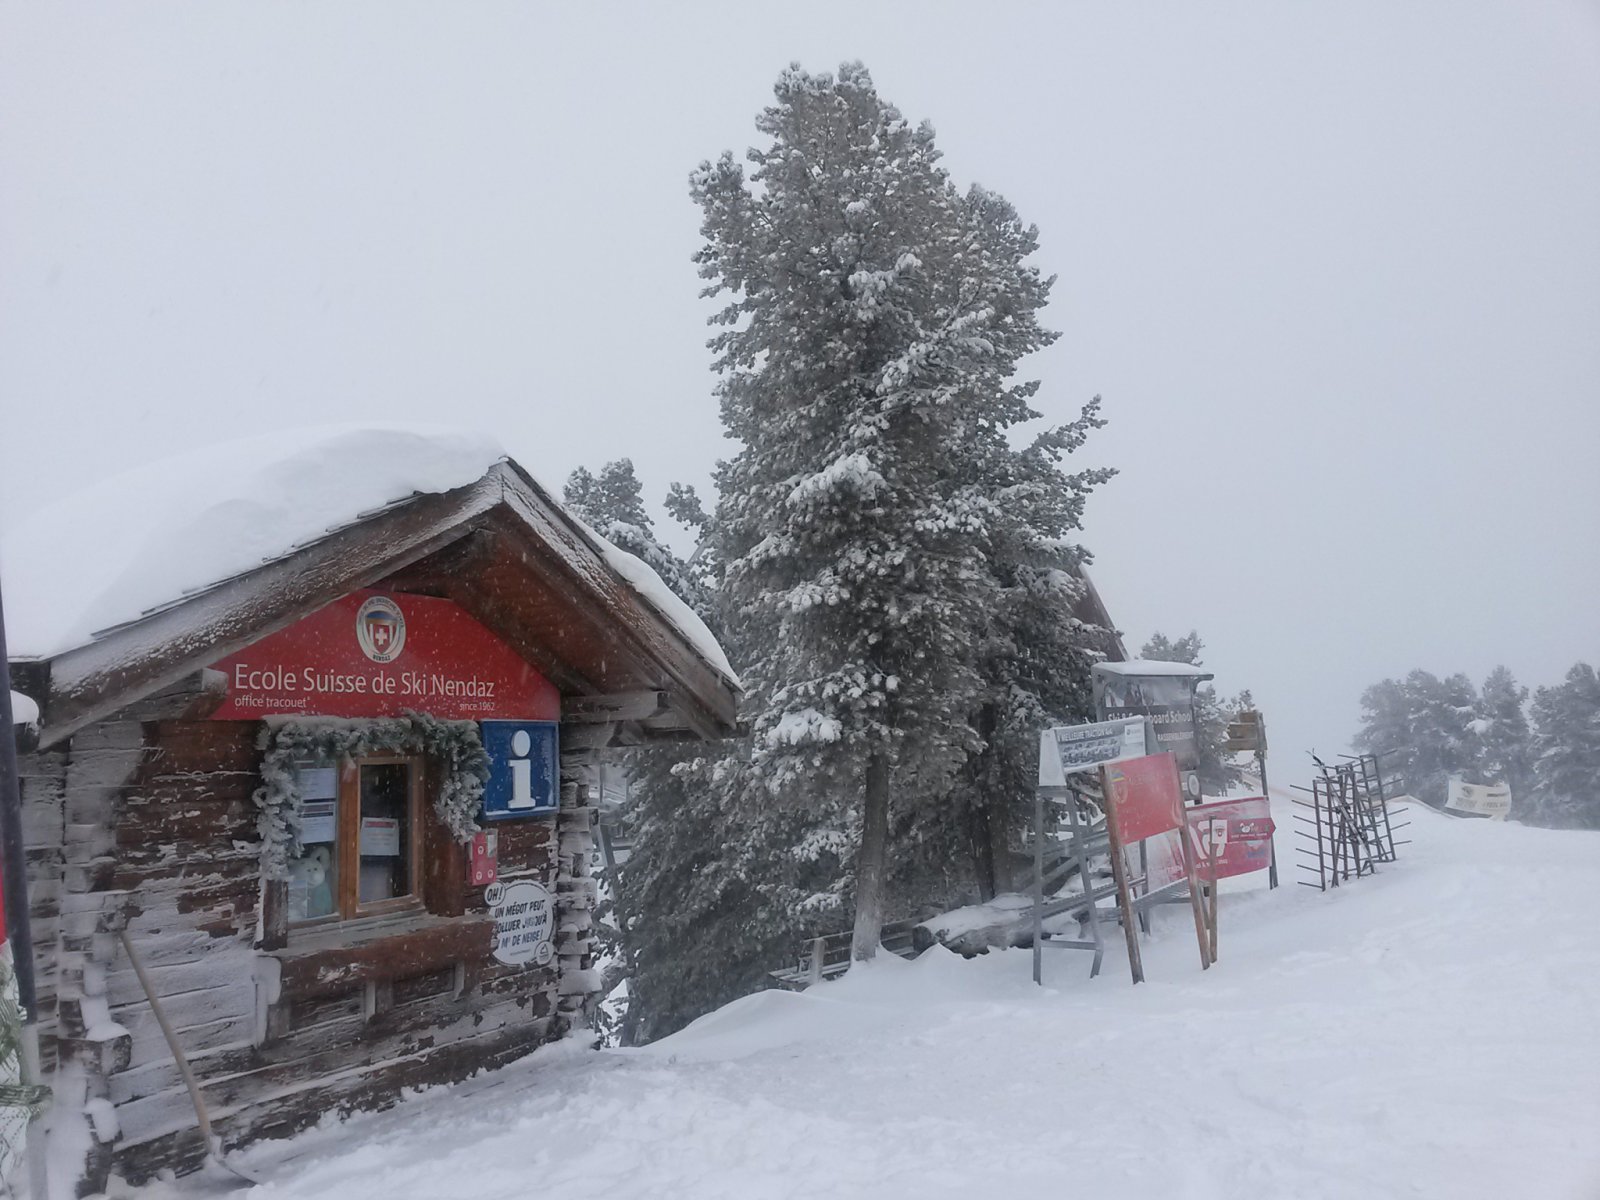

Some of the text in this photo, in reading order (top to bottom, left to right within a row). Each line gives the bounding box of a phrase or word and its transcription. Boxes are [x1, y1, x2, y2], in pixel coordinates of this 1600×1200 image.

[235, 664, 495, 697] Ecole Suisse de Ski Nendaz
[234, 694, 307, 708] office tracouet
[459, 701, 496, 712] since 1962
[1170, 709, 1193, 724] School
[508, 730, 537, 809] i
[487, 886, 503, 902] OH!
[494, 899, 546, 919] UN MÉGOT PEUT
[496, 919, 521, 933] OLLUER
[512, 934, 521, 947] DE
